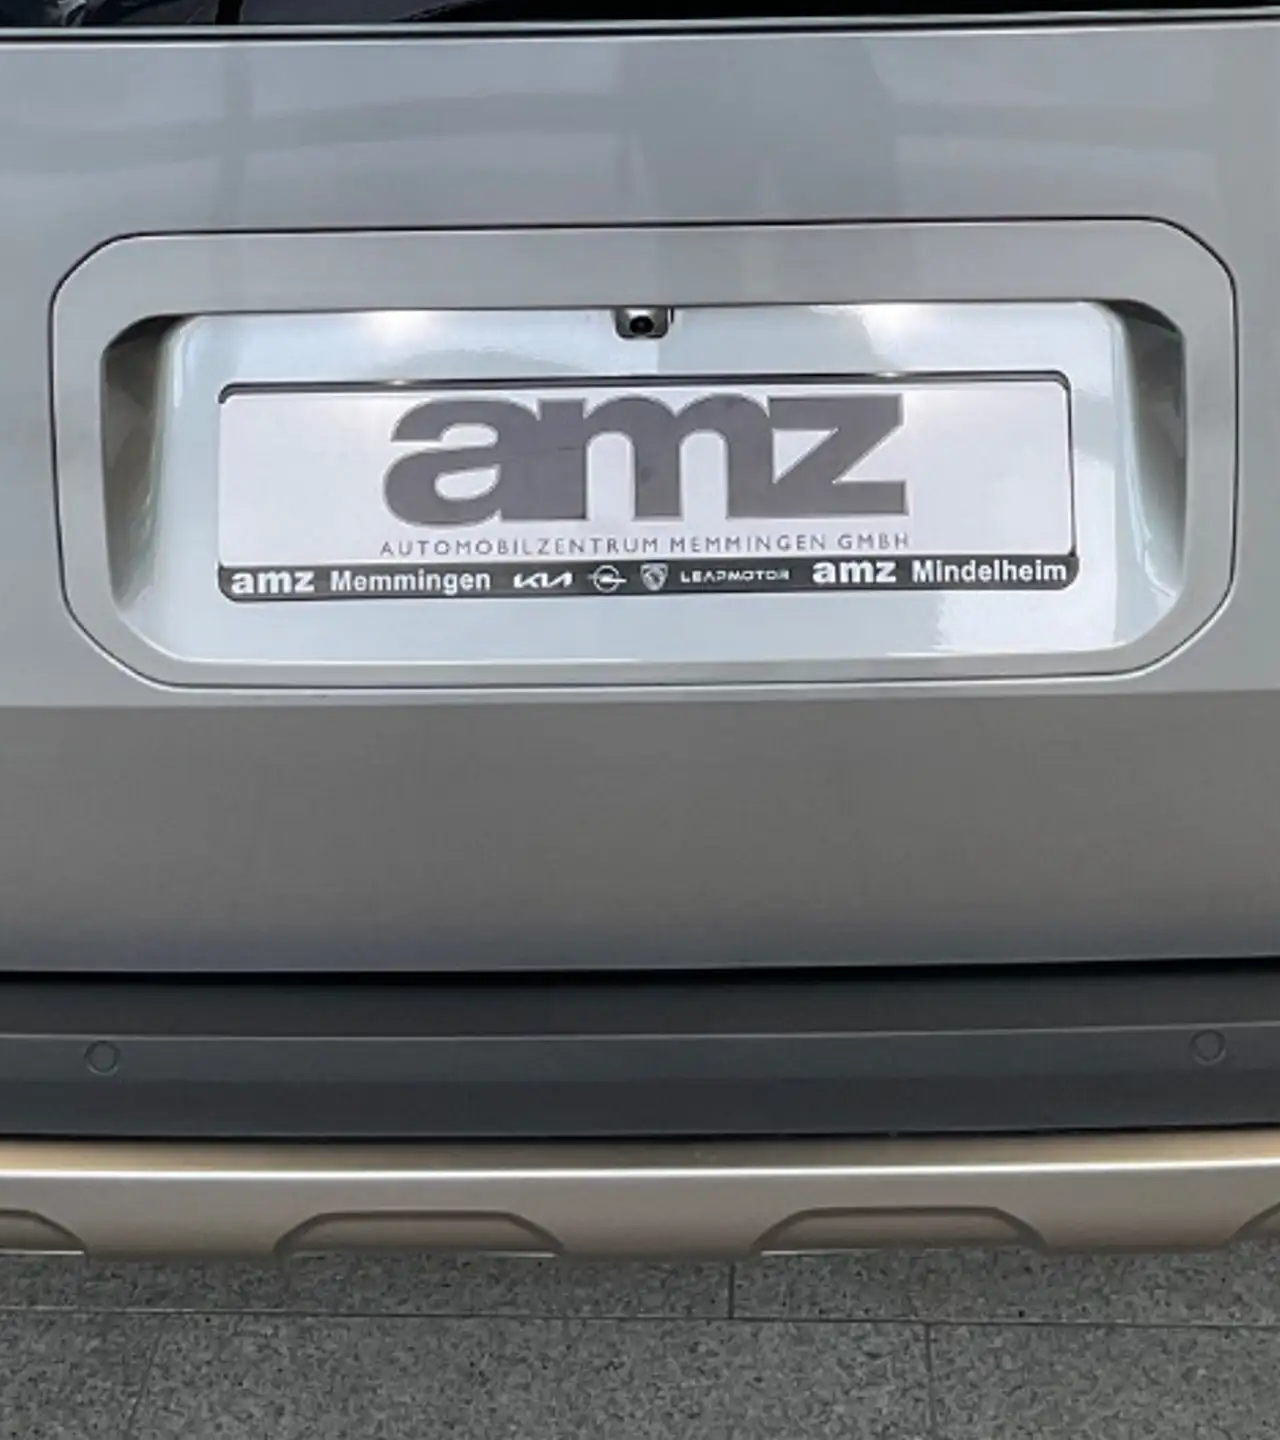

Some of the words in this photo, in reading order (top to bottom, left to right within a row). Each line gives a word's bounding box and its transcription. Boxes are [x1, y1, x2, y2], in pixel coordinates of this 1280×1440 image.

[383, 394, 906, 526] amz
[380, 536, 659, 557] AUTOMOBILZENTRUM
[668, 534, 827, 553] MEMMINGEN
[837, 532, 910, 550] GMBH
[231, 570, 315, 595] amz
[329, 569, 492, 597] Memmingen
[812, 559, 897, 584] amz
[911, 556, 1067, 584] Mindelheim
